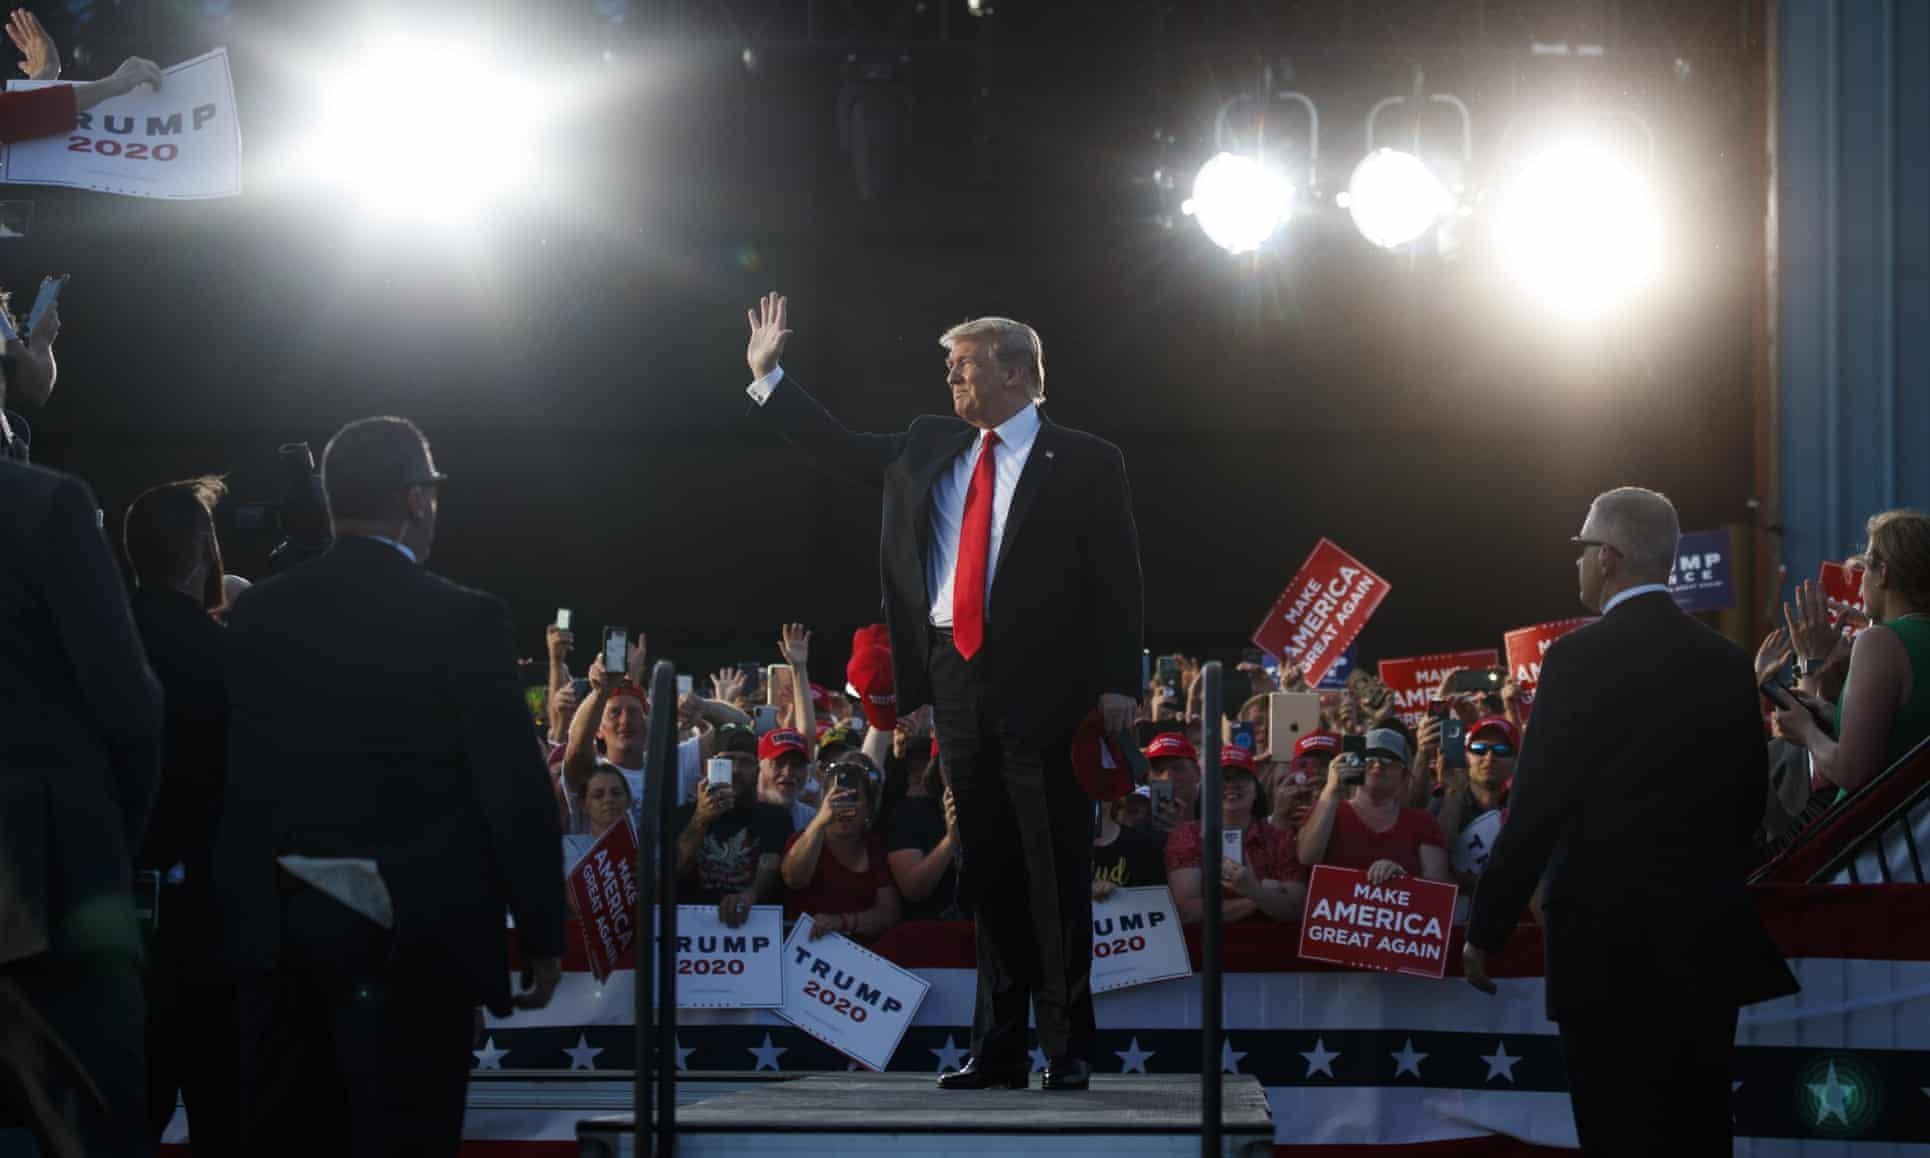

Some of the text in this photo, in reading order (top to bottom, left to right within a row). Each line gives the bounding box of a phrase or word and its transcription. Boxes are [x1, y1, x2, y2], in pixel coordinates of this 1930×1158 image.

[75, 103, 216, 136] RUMP
[67, 136, 179, 161] 2020
[1284, 566, 1361, 658] AMERICA
[1285, 578, 1322, 624] MAKE
[1301, 623, 1338, 674] GREAT
[1336, 576, 1374, 627] AGAIN
[594, 849, 633, 951] AMERICA
[1353, 883, 1411, 906] MAKE
[1094, 911, 1166, 937] UMP
[1311, 898, 1442, 940] AMERICA
[674, 936, 770, 953] RUMP
[1094, 935, 1146, 958] 020
[1308, 925, 1441, 961] GREAT AGAIN
[678, 959, 745, 975] 2020
[794, 946, 902, 1013] TRUMP
[802, 980, 867, 1022] 2020
